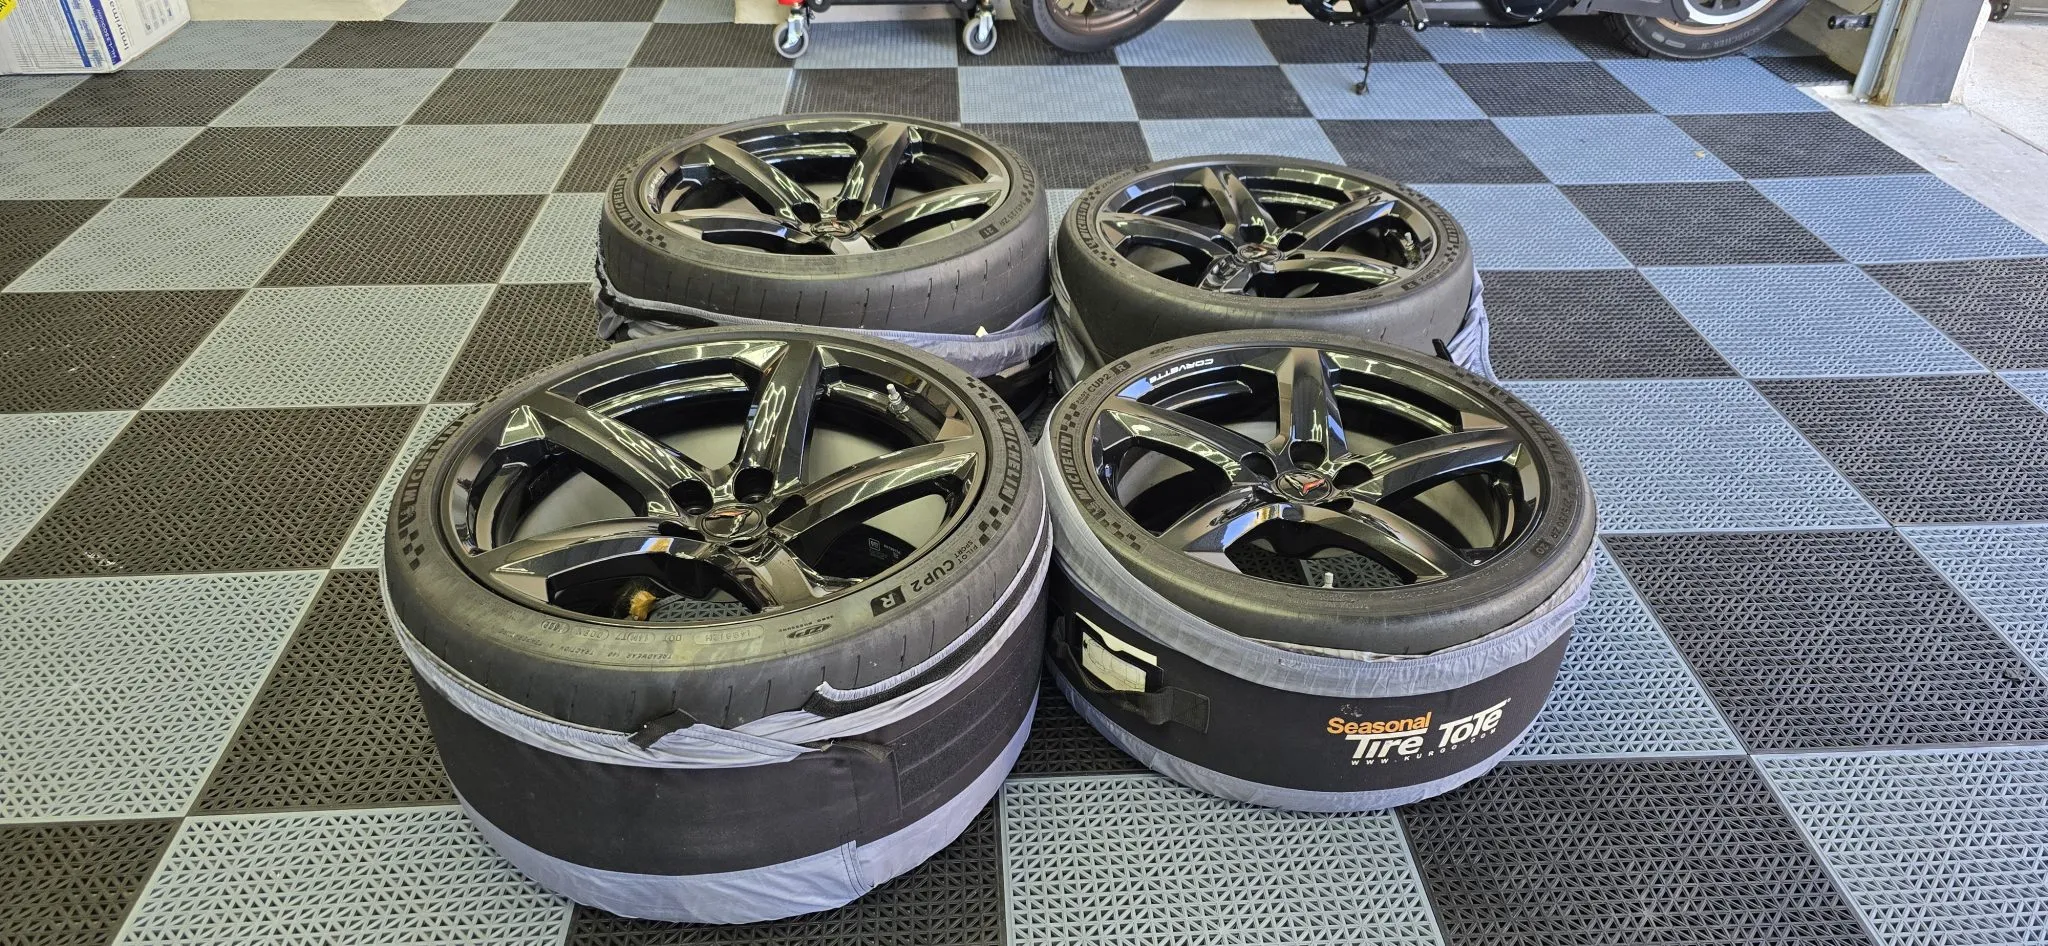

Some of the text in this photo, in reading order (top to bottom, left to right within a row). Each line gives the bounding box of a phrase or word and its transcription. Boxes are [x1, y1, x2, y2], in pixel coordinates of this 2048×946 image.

[613, 179, 632, 220] MICHELIN
[1118, 364, 1126, 372] R
[1149, 358, 1214, 383] CORVETTE
[402, 423, 461, 503] MICHELIN
[1000, 420, 1021, 501] MICHELIN
[1058, 433, 1092, 501] MICHELIN
[953, 540, 973, 558] SPORT
[958, 545, 978, 564] PILOT
[1535, 542, 1547, 555] 20
[880, 593, 895, 608] R
[1326, 711, 1432, 735] Seasonal
[1345, 728, 1429, 759] Tire
